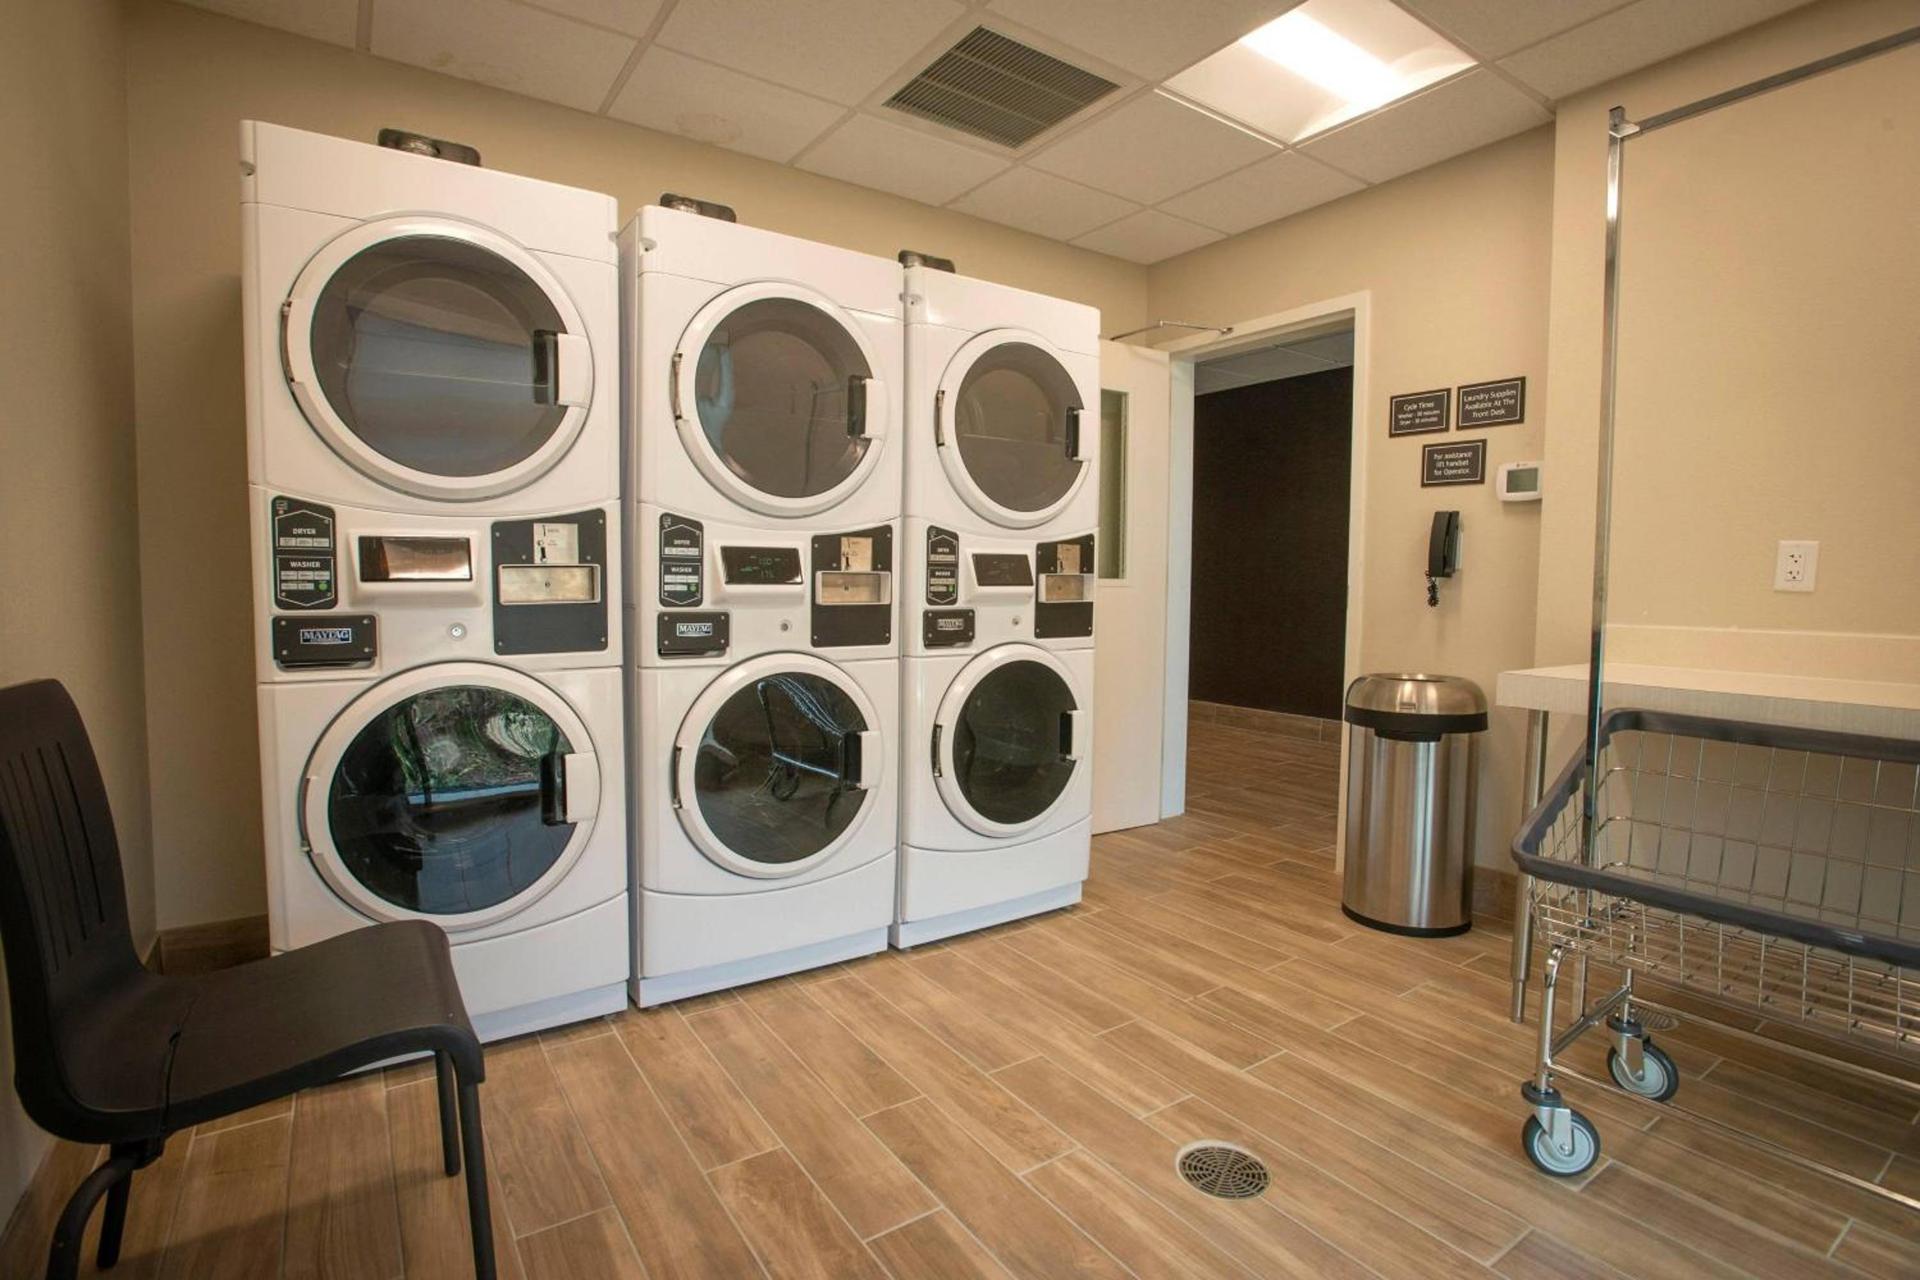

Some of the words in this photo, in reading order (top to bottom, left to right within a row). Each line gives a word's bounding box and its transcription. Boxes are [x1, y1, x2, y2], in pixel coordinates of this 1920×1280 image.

[1464, 393, 1489, 402] Laundry
[1490, 390, 1517, 399] Supplies
[1404, 403, 1417, 411] Cycle
[1464, 402, 1492, 410] Available
[1490, 408, 1505, 416] Desk
[303, 630, 349, 640] MAYTAG
